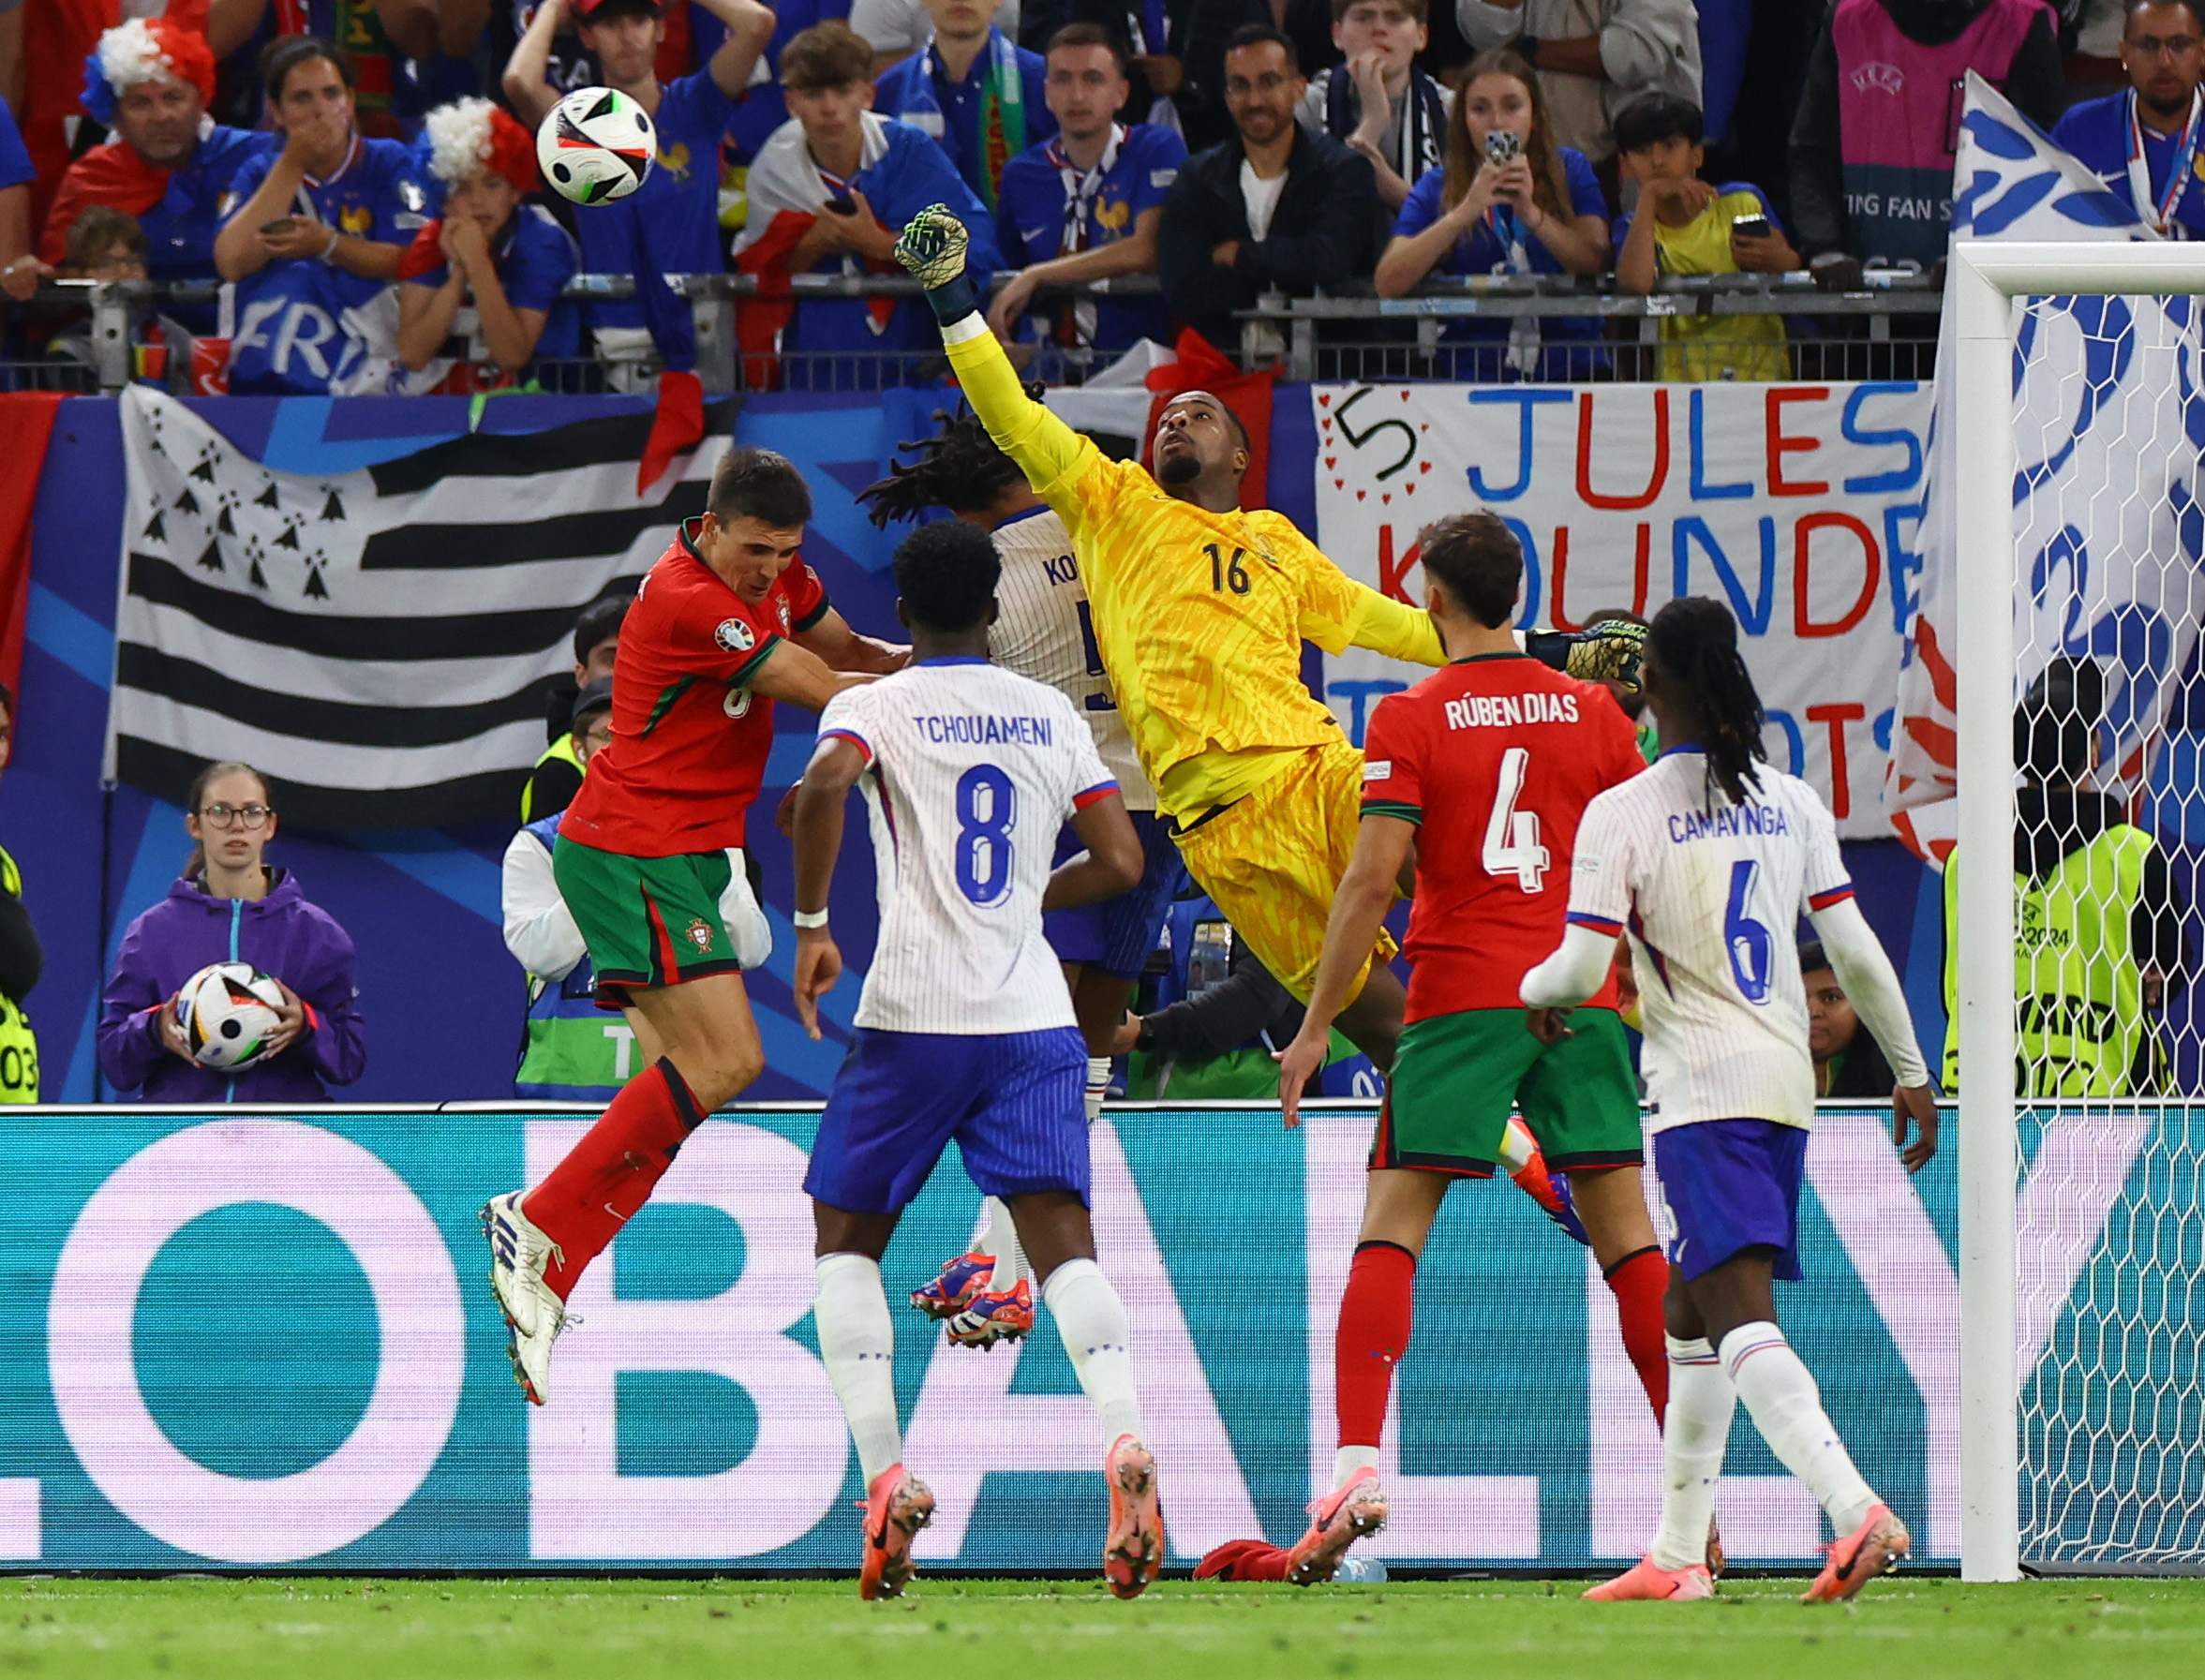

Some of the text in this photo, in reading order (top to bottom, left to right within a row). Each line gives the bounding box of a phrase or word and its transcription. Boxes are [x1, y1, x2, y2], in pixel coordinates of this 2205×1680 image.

[1845, 193, 1881, 216] ING
[1887, 197, 1932, 221] FAN
[1333, 388, 1418, 482] 5
[1467, 380, 1923, 511] JULES
[1202, 543, 1252, 597] 16
[913, 714, 1053, 748] TCHOUAMENI
[1443, 691, 1580, 731] RÚBEN DIAS
[954, 763, 1018, 910] 8
[1482, 747, 1551, 894] 4
[1723, 858, 1775, 1006] 6
